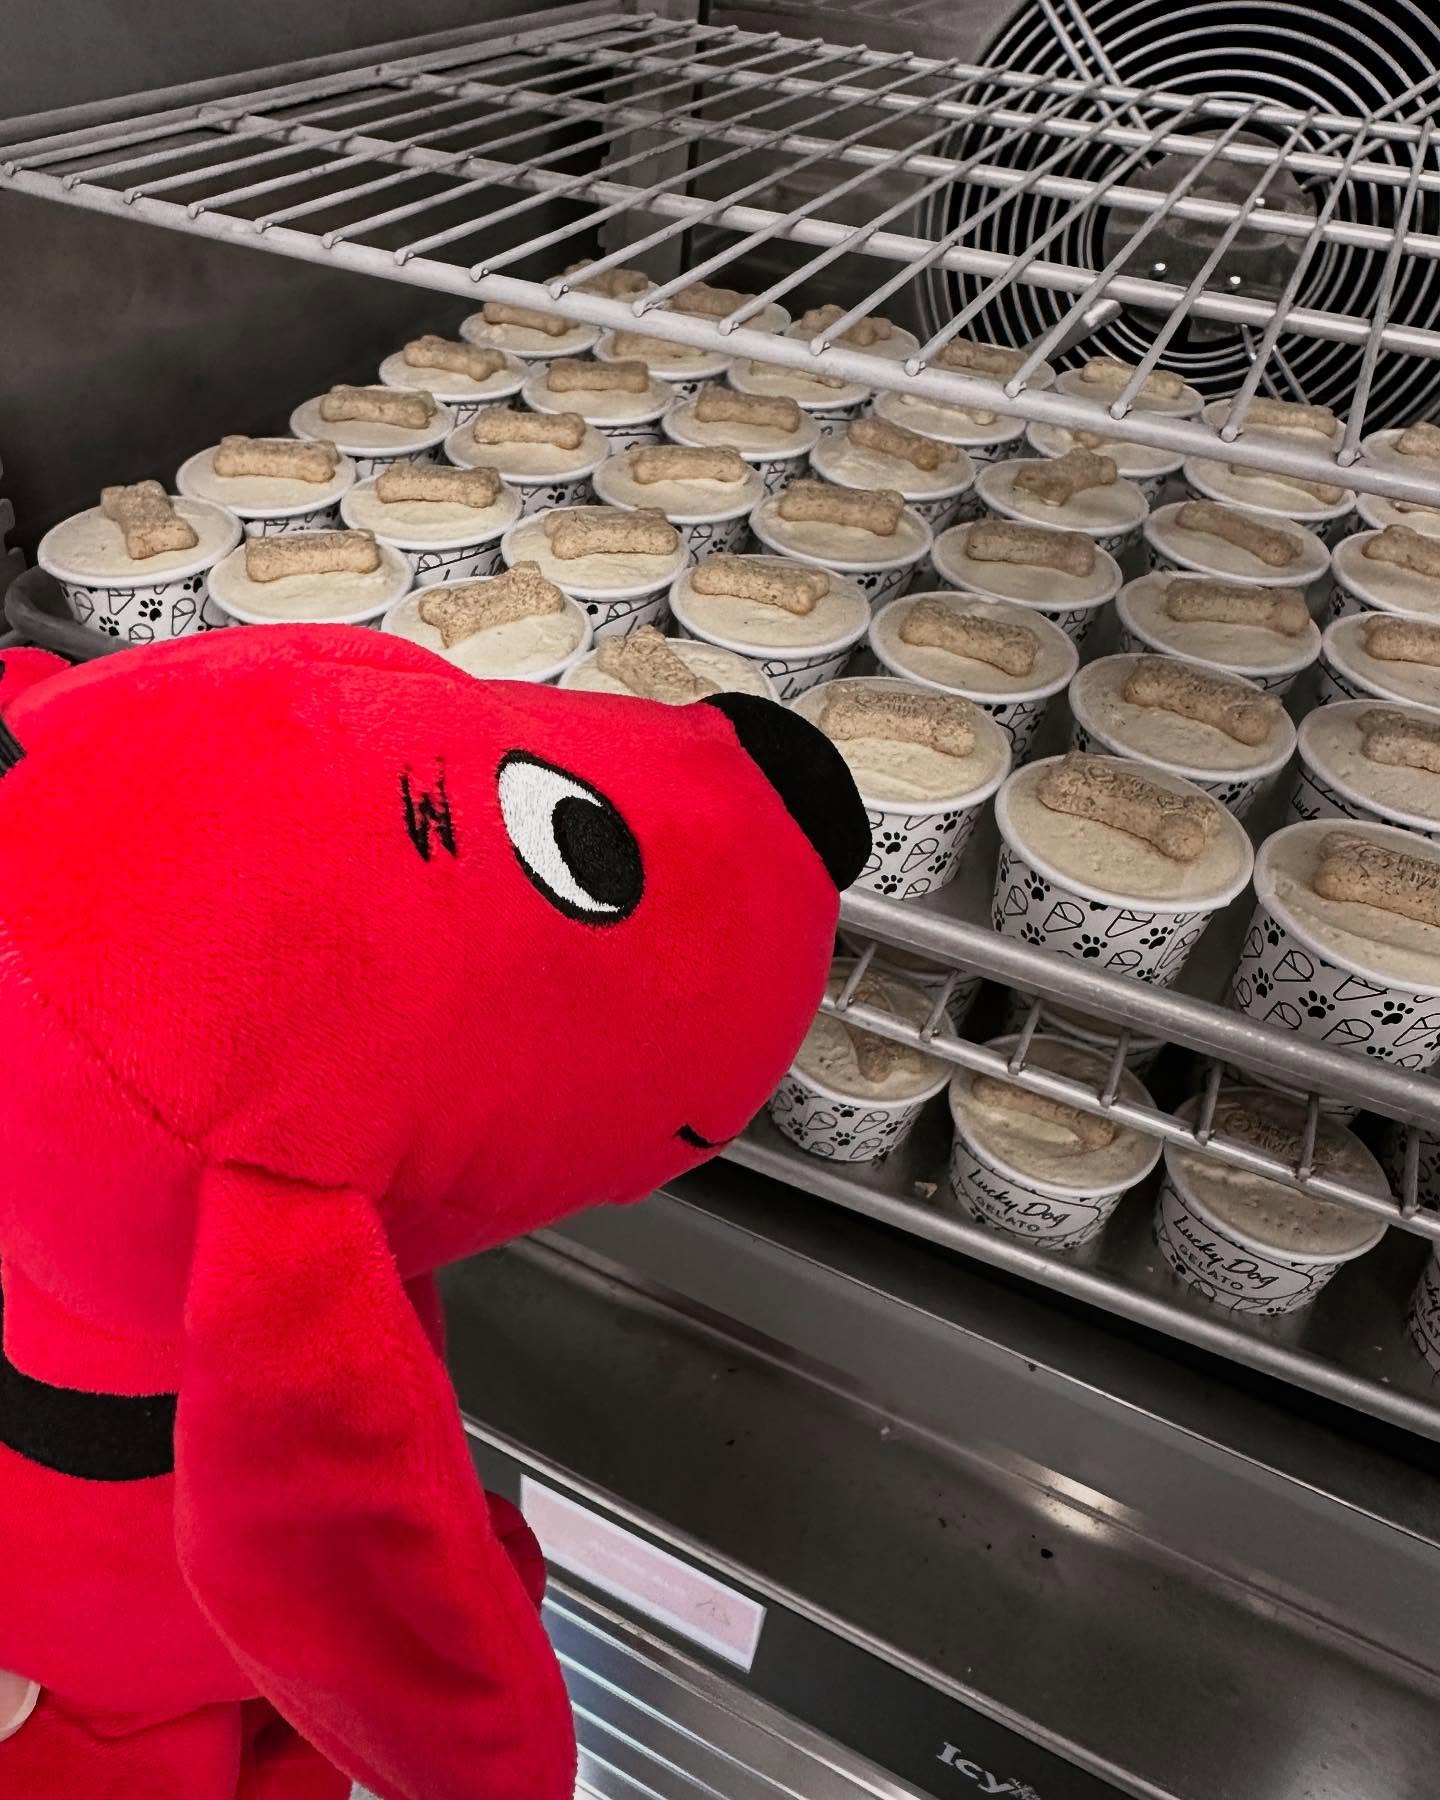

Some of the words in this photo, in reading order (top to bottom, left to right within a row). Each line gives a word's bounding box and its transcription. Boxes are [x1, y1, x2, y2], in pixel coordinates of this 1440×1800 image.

[967, 1168, 1019, 1215] Lucky
[1016, 1202, 1072, 1229] Dog
[975, 1196, 1041, 1232] GELATO
[1173, 1215, 1225, 1269] Lucky
[1221, 1258, 1280, 1290] Dog
[1178, 1243, 1244, 1291] GELATO
[935, 1741, 1016, 1794] Icy
